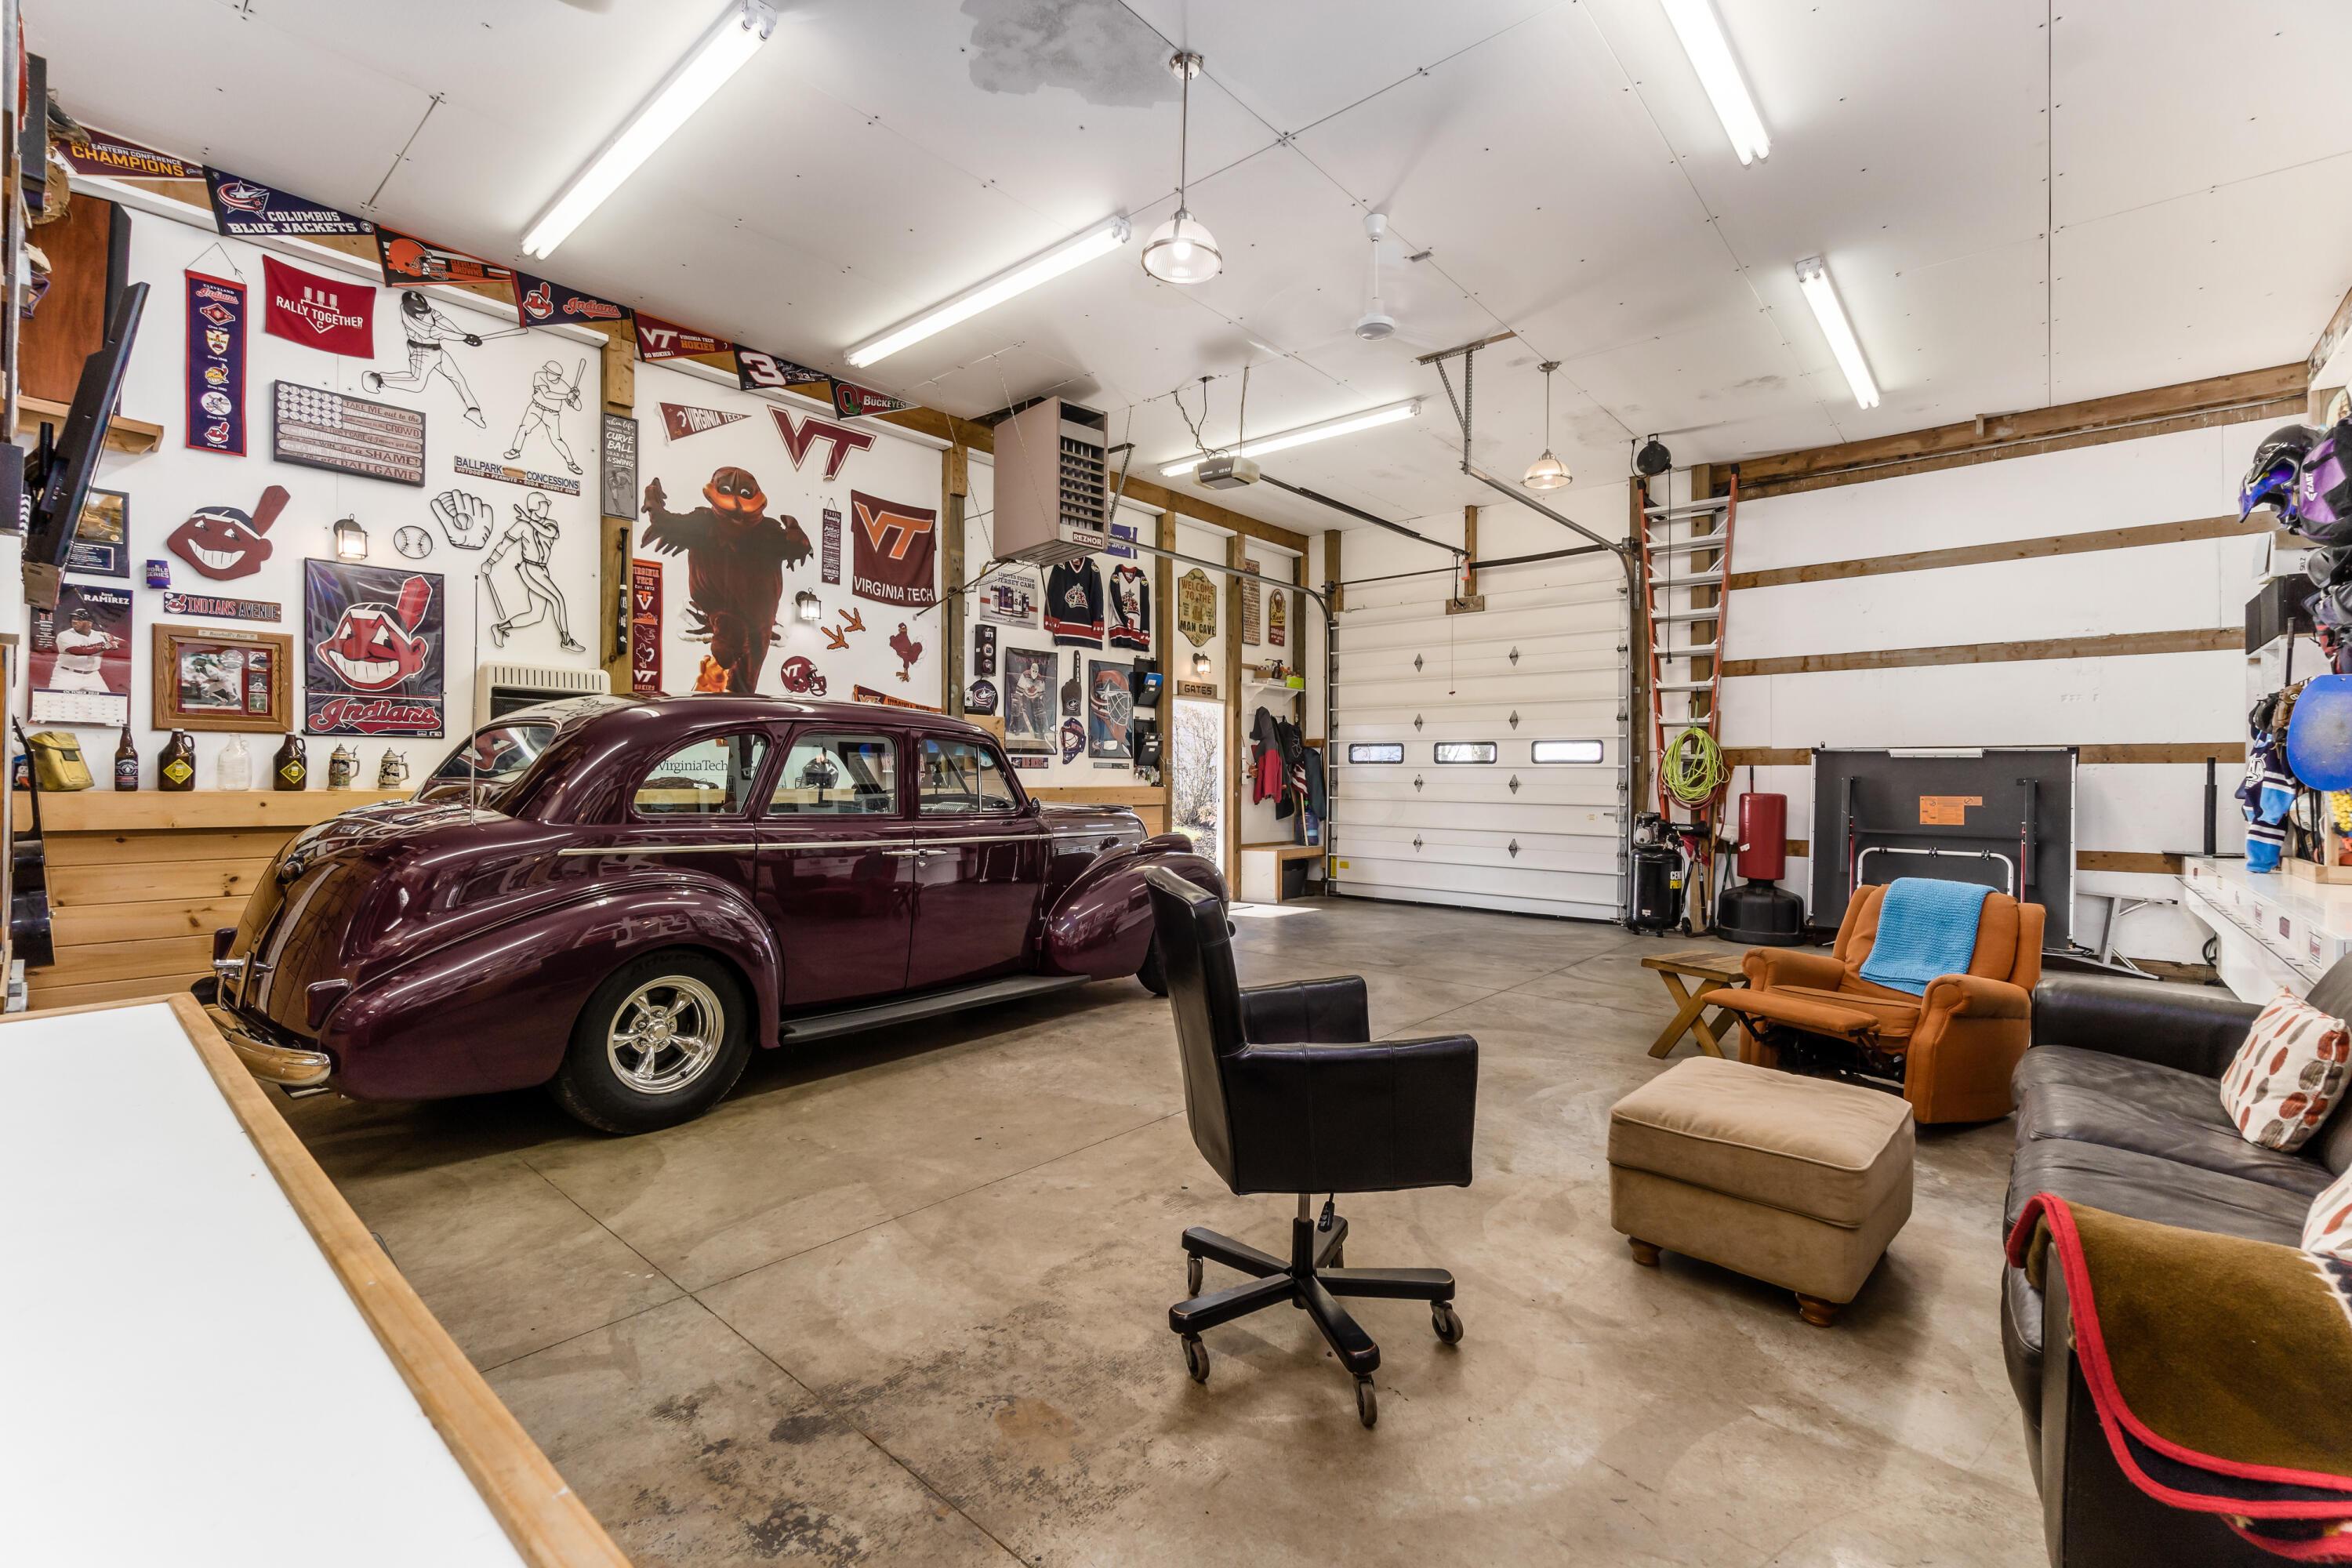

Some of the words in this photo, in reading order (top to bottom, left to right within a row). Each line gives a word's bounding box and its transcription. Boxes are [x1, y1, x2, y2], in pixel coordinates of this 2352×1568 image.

[71, 145, 185, 177] CHAMPIONS
[91, 143, 129, 156] EASTERN
[129, 151, 182, 165] CONFERENCE
[267, 211, 340, 222] COLUMBUS
[227, 223, 279, 234] BLUE
[281, 222, 358, 234] JACKETS
[452, 266, 485, 277] BROWNS
[196, 288, 239, 305] Indians
[203, 284, 234, 295] CLEVELAND
[276, 295, 309, 316] RALLY
[311, 308, 363, 328] TOGETHER
[563, 297, 621, 318] Indians
[638, 326, 678, 348] VT
[681, 339, 715, 352] HOKIES
[740, 351, 786, 386] 3
[863, 394, 906, 408] BUCKEYES
[345, 401, 366, 411] TAKE
[408, 415, 419, 423] the
[684, 407, 721, 432] VIRGINIA
[721, 412, 743, 423] TECH
[386, 424, 419, 437] CROWD
[607, 432, 633, 444] CURVE
[608, 440, 633, 453] BALL
[767, 405, 877, 481] VT
[365, 449, 419, 466] SHAME!
[612, 457, 633, 467] SWING
[456, 457, 503, 474] BALLPARK
[526, 471, 579, 489] CONCESSIONS
[457, 467, 485, 477] HOTDOGS
[491, 474, 517, 483] PEANUTS
[543, 484, 564, 492] BUBBLE
[854, 500, 934, 561] VT
[1073, 533, 1102, 546] REZNOR
[636, 576, 653, 586] TECH
[998, 572, 1016, 580] LIMITED
[1017, 575, 1035, 583] EDITION
[998, 577, 1019, 586] JERSEY
[1020, 581, 1035, 590] CANS
[854, 575, 904, 601] VIRGINIA
[907, 588, 934, 602] TECH
[1181, 579, 1214, 595] WELCOME
[84, 594, 130, 604] RAMIREZ
[1185, 590, 1194, 601] TO
[1199, 593, 1211, 604] THE
[187, 597, 236, 616] INDIANS
[238, 602, 279, 619] AVENUE
[1180, 620, 1196, 633] MAN
[1199, 624, 1215, 635] CAVE
[633, 670, 658, 683] VT
[782, 663, 802, 678] VT
[1185, 684, 1212, 695] GATES
[308, 698, 441, 735] Indians
